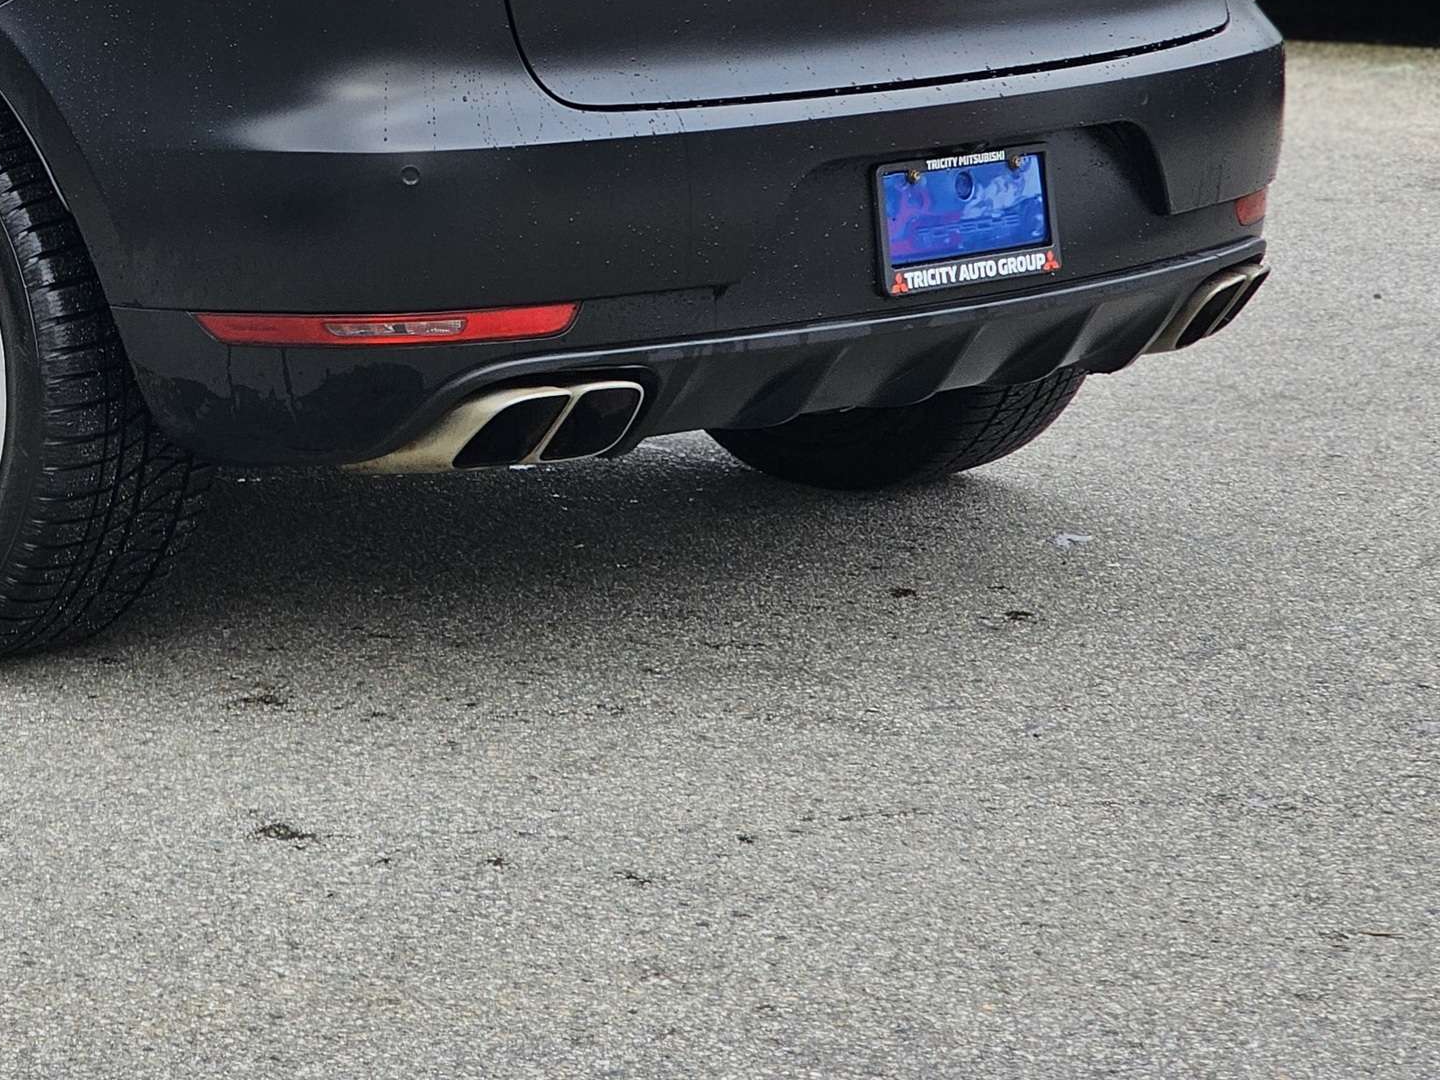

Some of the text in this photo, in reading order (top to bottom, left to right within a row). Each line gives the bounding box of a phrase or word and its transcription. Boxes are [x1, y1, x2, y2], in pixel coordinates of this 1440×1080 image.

[926, 150, 1006, 171] TRICITY MITSUBISHI
[904, 252, 1047, 289] TRICITY AUTO GROUP
